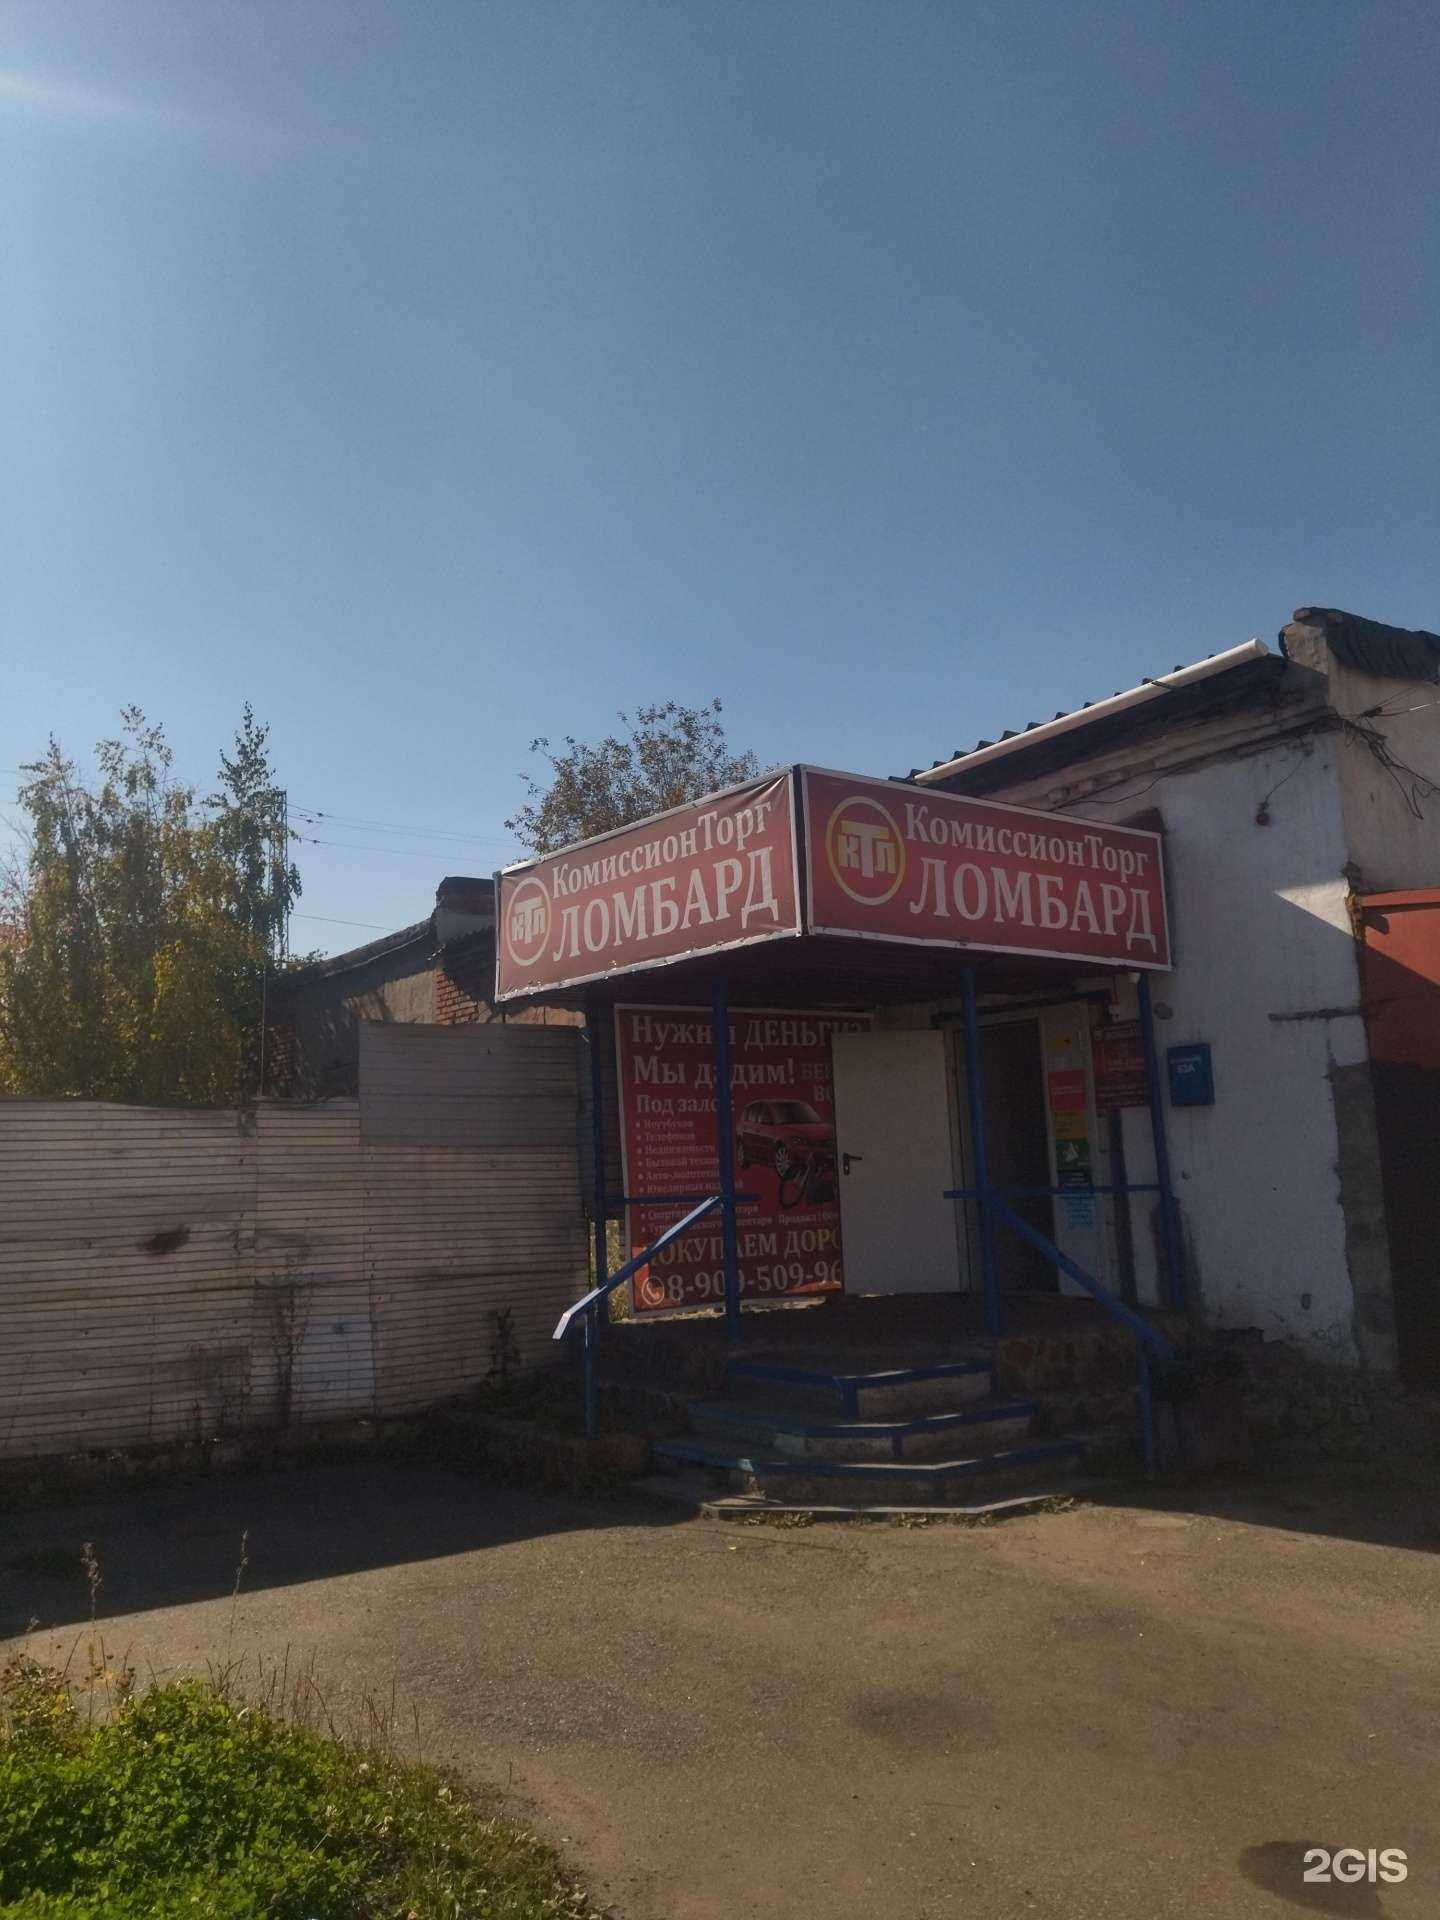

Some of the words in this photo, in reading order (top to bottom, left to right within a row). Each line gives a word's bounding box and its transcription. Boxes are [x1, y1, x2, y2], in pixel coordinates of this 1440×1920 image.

[552, 801, 773, 898] КомиссионТорг
[904, 803, 1148, 883] КомиссионТорг
[553, 847, 779, 962] ЛОМБАРД
[909, 857, 1156, 953] ЛОМБАРД
[632, 1015, 736, 1050] Нужн
[633, 1056, 685, 1085] Мы
[694, 1057, 796, 1091] ддим!
[637, 1095, 675, 1116] Под
[678, 1098, 735, 1114] зало:
